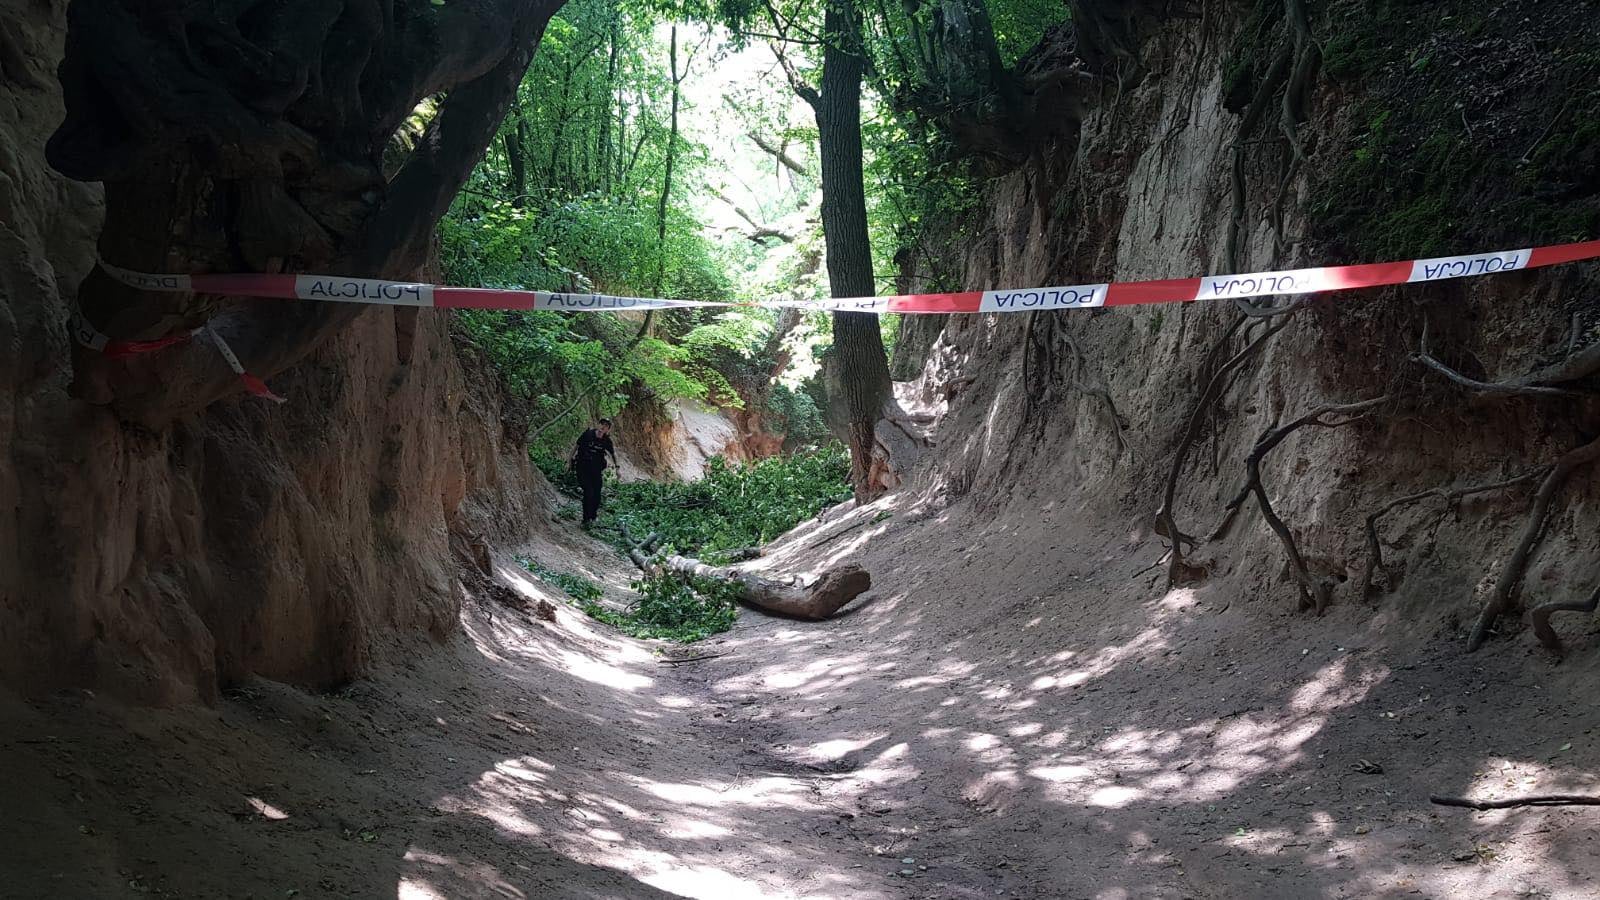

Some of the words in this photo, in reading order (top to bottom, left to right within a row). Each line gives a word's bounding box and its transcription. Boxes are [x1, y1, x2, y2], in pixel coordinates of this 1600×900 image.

[1425, 255, 1519, 279] POLICJA
[1213, 274, 1311, 295] POLICJA
[995, 289, 1095, 307] POLICJA
